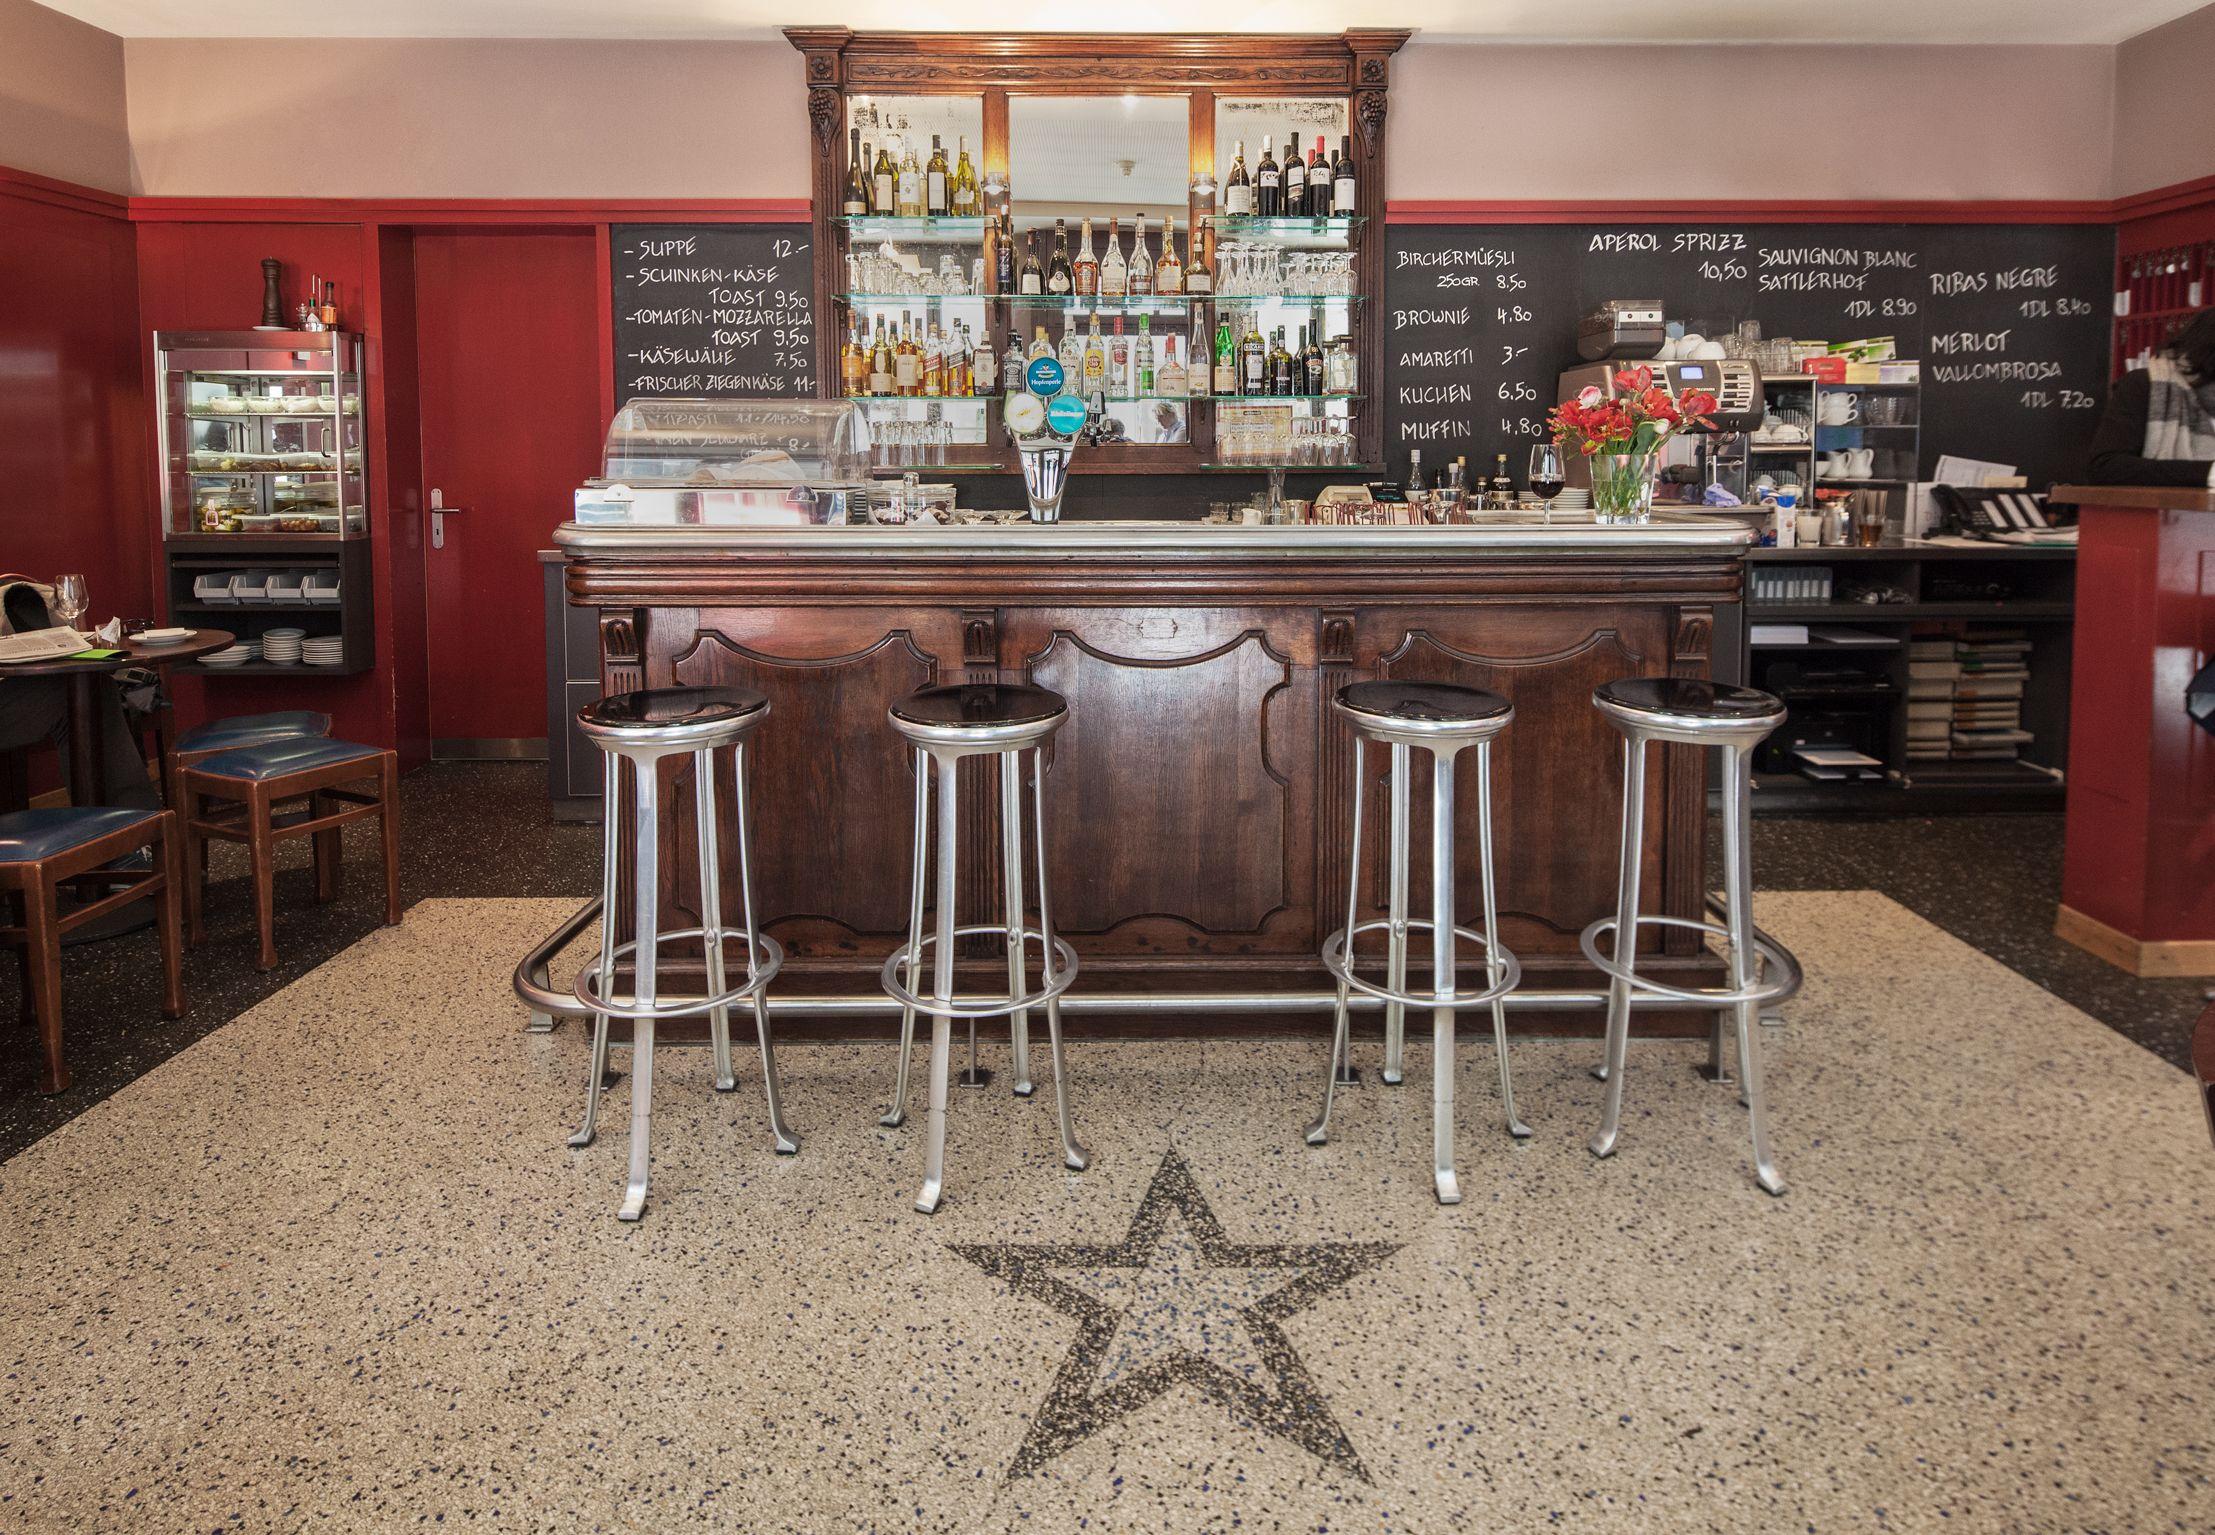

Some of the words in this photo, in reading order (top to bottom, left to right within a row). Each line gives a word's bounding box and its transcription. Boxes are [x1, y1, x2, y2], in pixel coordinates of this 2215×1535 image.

[638, 236, 697, 260] SUPPE
[1588, 232, 1662, 252] APEROL
[1671, 233, 1748, 253] SPRIZZ
[1395, 248, 1515, 270] BIRCHERMÜESLI
[1758, 247, 1858, 268] SAUVIGNON
[1862, 251, 1918, 271] BLANC
[638, 264, 780, 287] SCHINKEN-KÄSE
[1496, 273, 1527, 292] 8.50
[1758, 271, 1870, 293] SATTLERHOF
[1929, 271, 1988, 297] RIBAS
[1996, 264, 2059, 291] NEGRE
[708, 287, 766, 306] TOAST
[774, 289, 809, 310] 9.50
[1844, 300, 1876, 319] 1DL
[2019, 300, 2052, 318] 1DL
[1393, 307, 1471, 330] BROWNIE
[711, 329, 762, 348] TOAST
[1931, 329, 2012, 354] MERLOT
[1400, 347, 1474, 367] AMARETTI
[705, 373, 786, 391] ZIEGENKÄSE
[1932, 361, 2062, 383] VALLOMBROSA
[1400, 383, 1472, 404] KUCHEN
[1498, 381, 1537, 400] 6.50
[1401, 419, 1471, 440] MUFFIN
